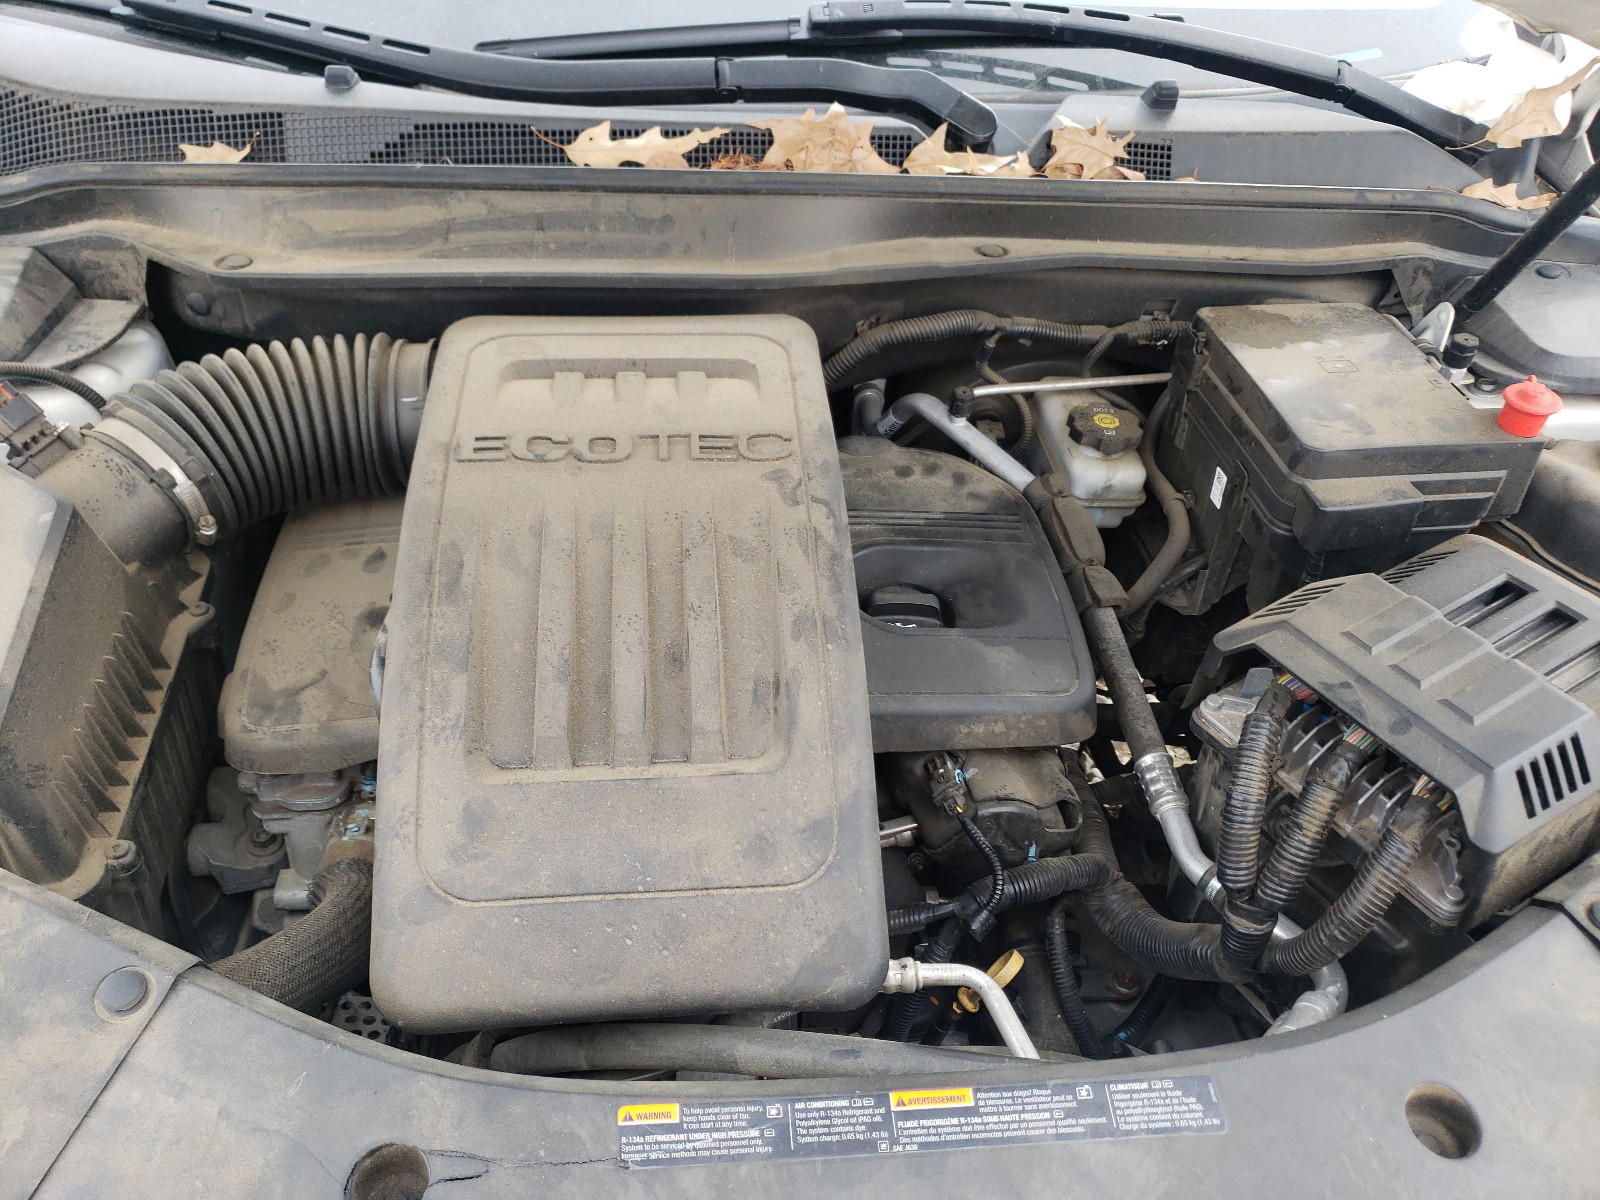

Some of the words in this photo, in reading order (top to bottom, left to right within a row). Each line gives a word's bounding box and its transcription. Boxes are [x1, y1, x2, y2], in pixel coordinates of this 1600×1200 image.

[454, 433, 793, 465] ECOTEC
[1110, 1082, 1148, 1091] CLIMATISEUR
[807, 1100, 849, 1108] CONDITIONING
[908, 1095, 966, 1105] AVERTISSEMENT
[691, 1107, 703, 1115] help
[705, 1106, 720, 1114] avoid
[721, 1106, 745, 1115] personal
[842, 1108, 873, 1116] Refrigerant
[636, 1112, 671, 1120] WARNING
[1021, 1112, 1050, 1120] PRESSION
[645, 1134, 688, 1142] REFRIGERANT
[689, 1132, 710, 1140] UNDER
[712, 1131, 728, 1139] HIGH
[729, 1130, 760, 1138] PRESSURE
[797, 1136, 818, 1144] System
[721, 1139, 749, 1148] personnel
[730, 1147, 754, 1155] personal
